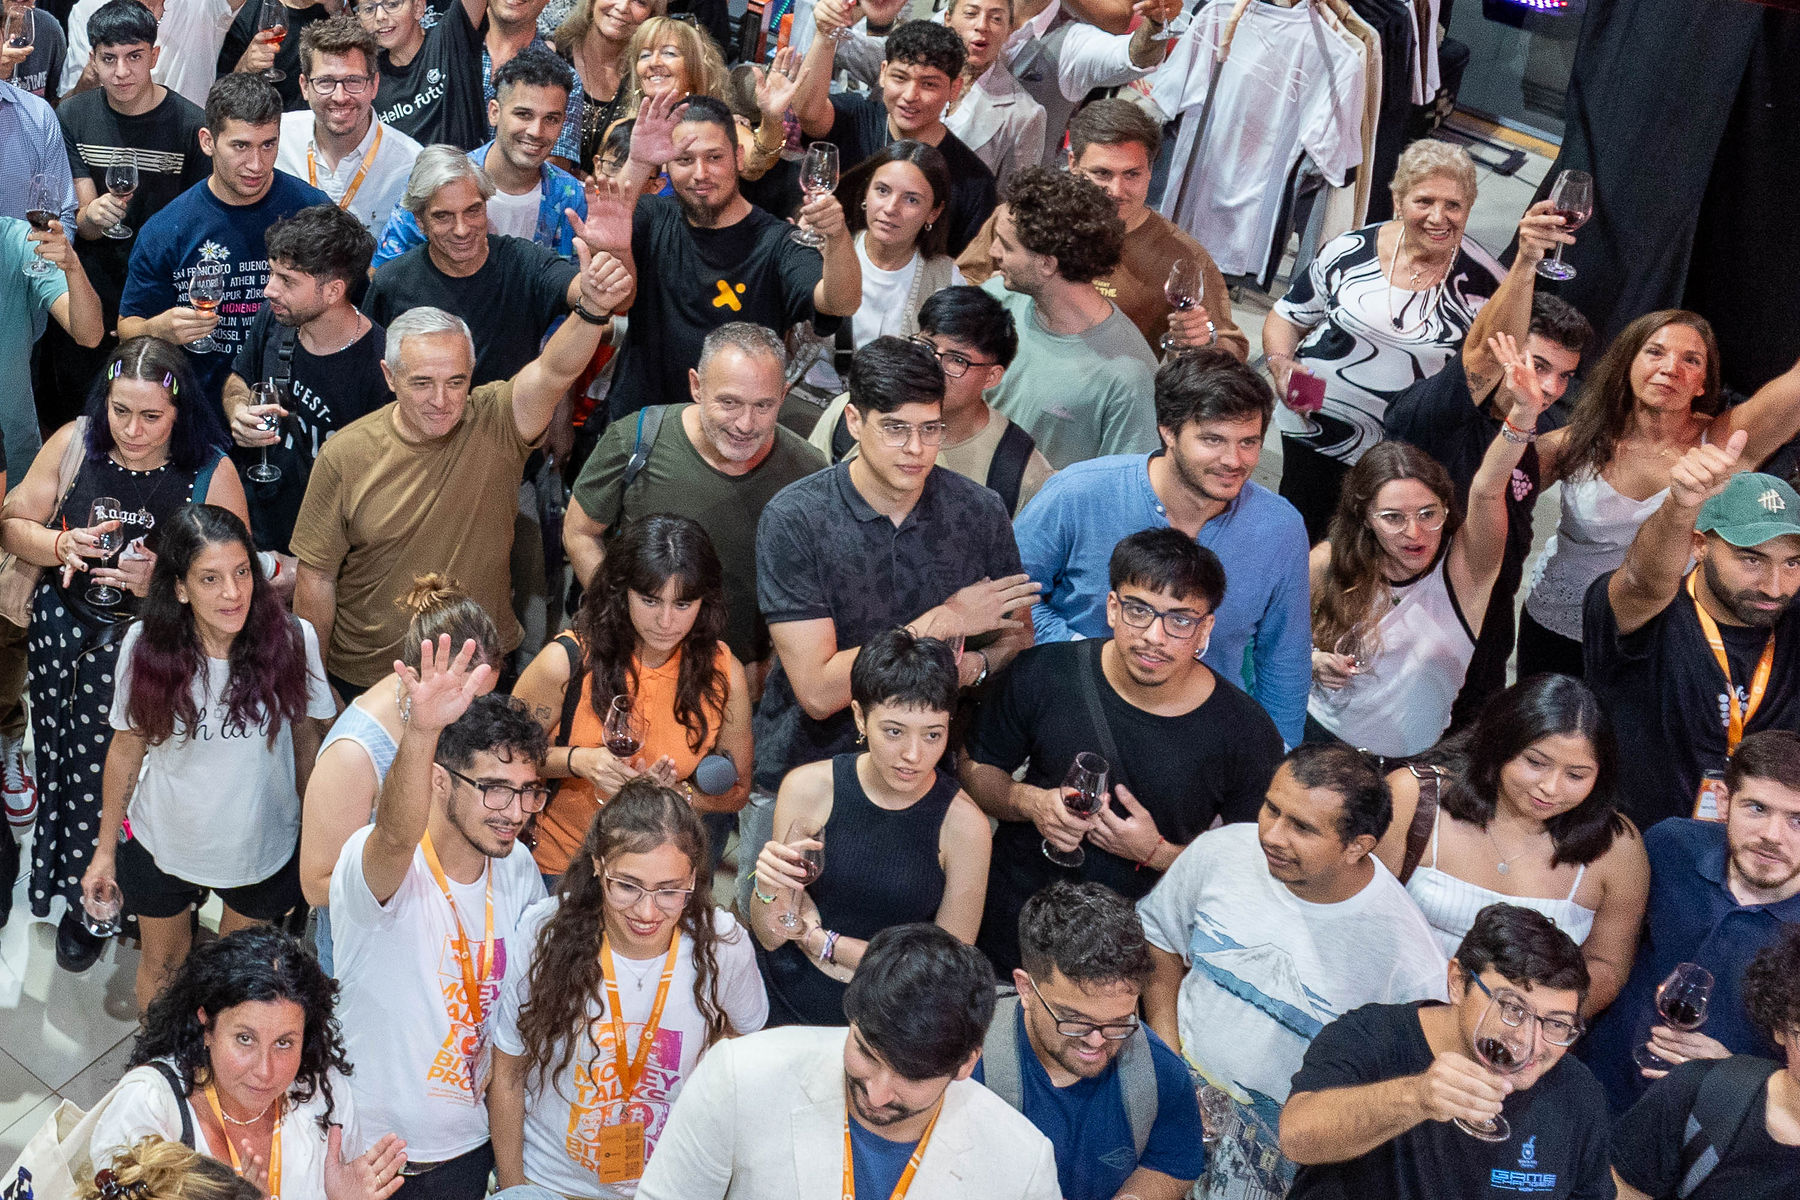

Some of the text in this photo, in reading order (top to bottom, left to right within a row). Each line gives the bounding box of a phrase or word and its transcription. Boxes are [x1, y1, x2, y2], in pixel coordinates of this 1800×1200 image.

[378, 102, 413, 124] Hello
[230, 275, 255, 287] ATHEN
[218, 316, 236, 327] RLIN
[213, 329, 241, 341] RÜSSEL
[573, 1062, 681, 1093] MOEY
[1490, 1167, 1558, 1183] GAME
